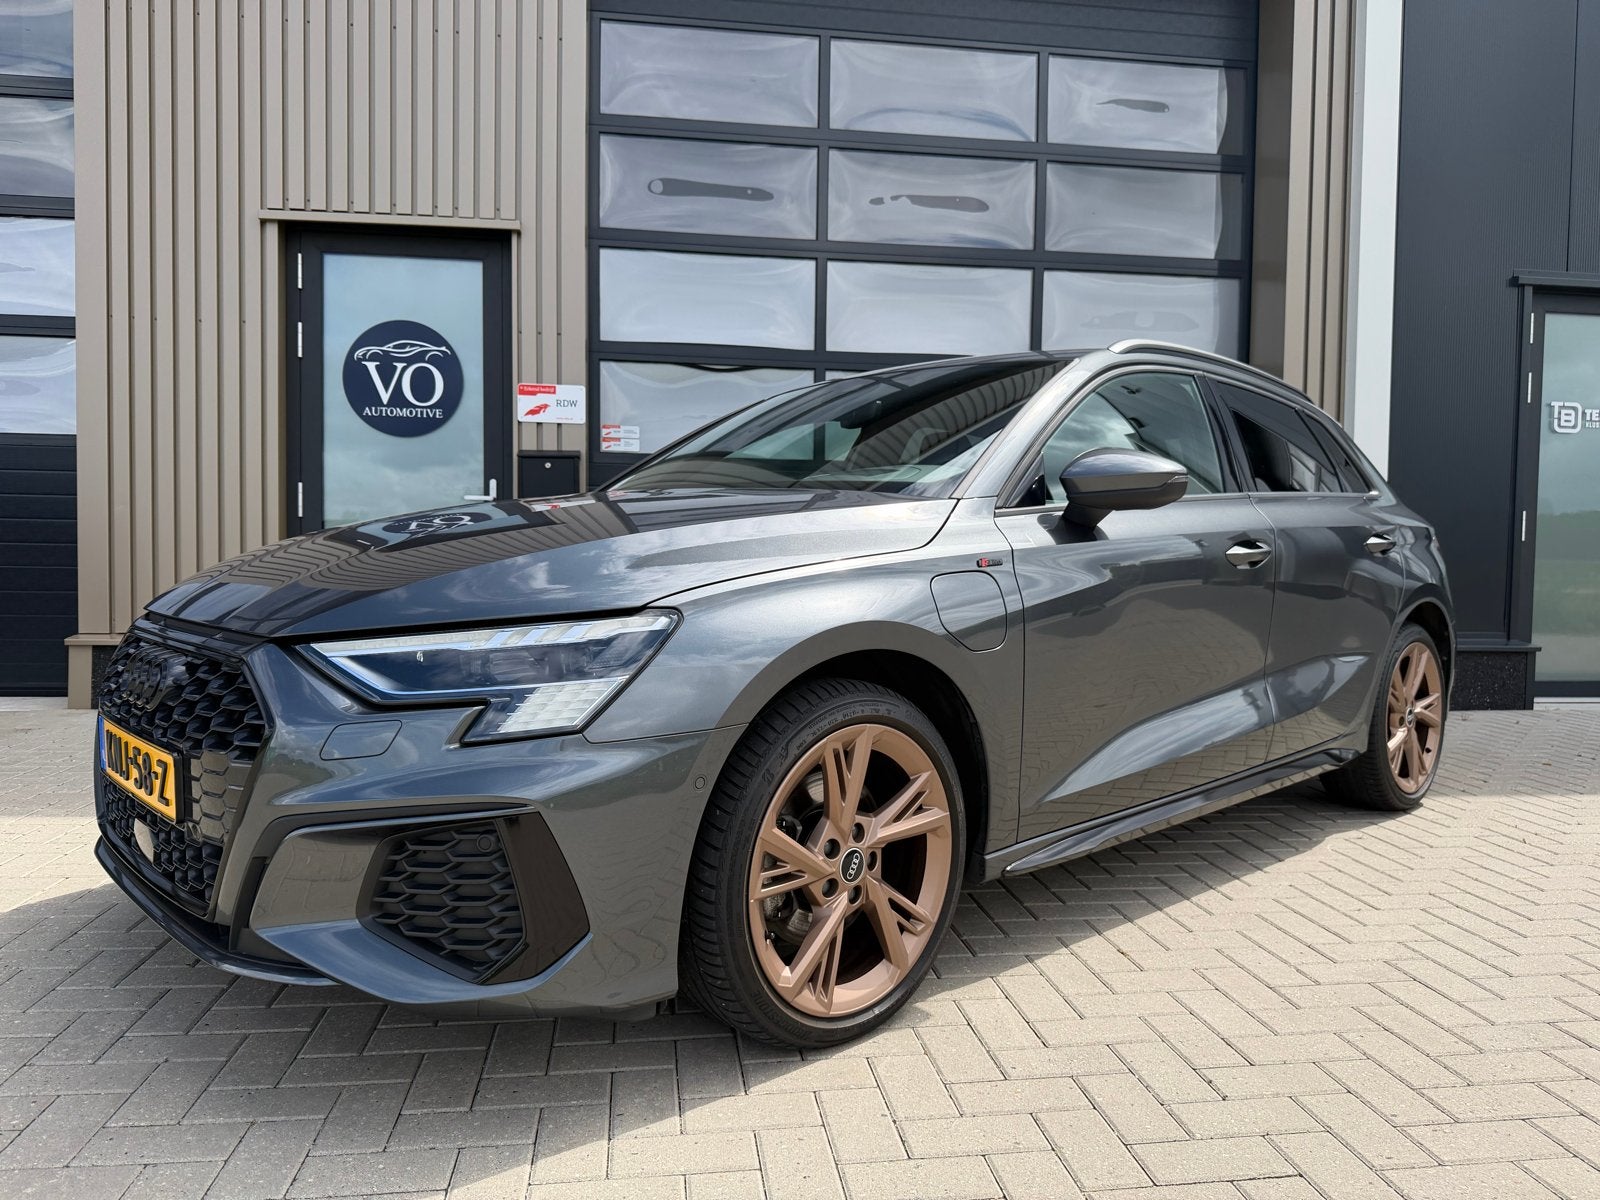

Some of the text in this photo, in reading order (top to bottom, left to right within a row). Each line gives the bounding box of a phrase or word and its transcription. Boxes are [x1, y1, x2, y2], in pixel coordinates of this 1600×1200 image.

[361, 361, 444, 407] VO
[556, 399, 578, 408] RDW
[362, 406, 444, 419] AUTOMOTIVE
